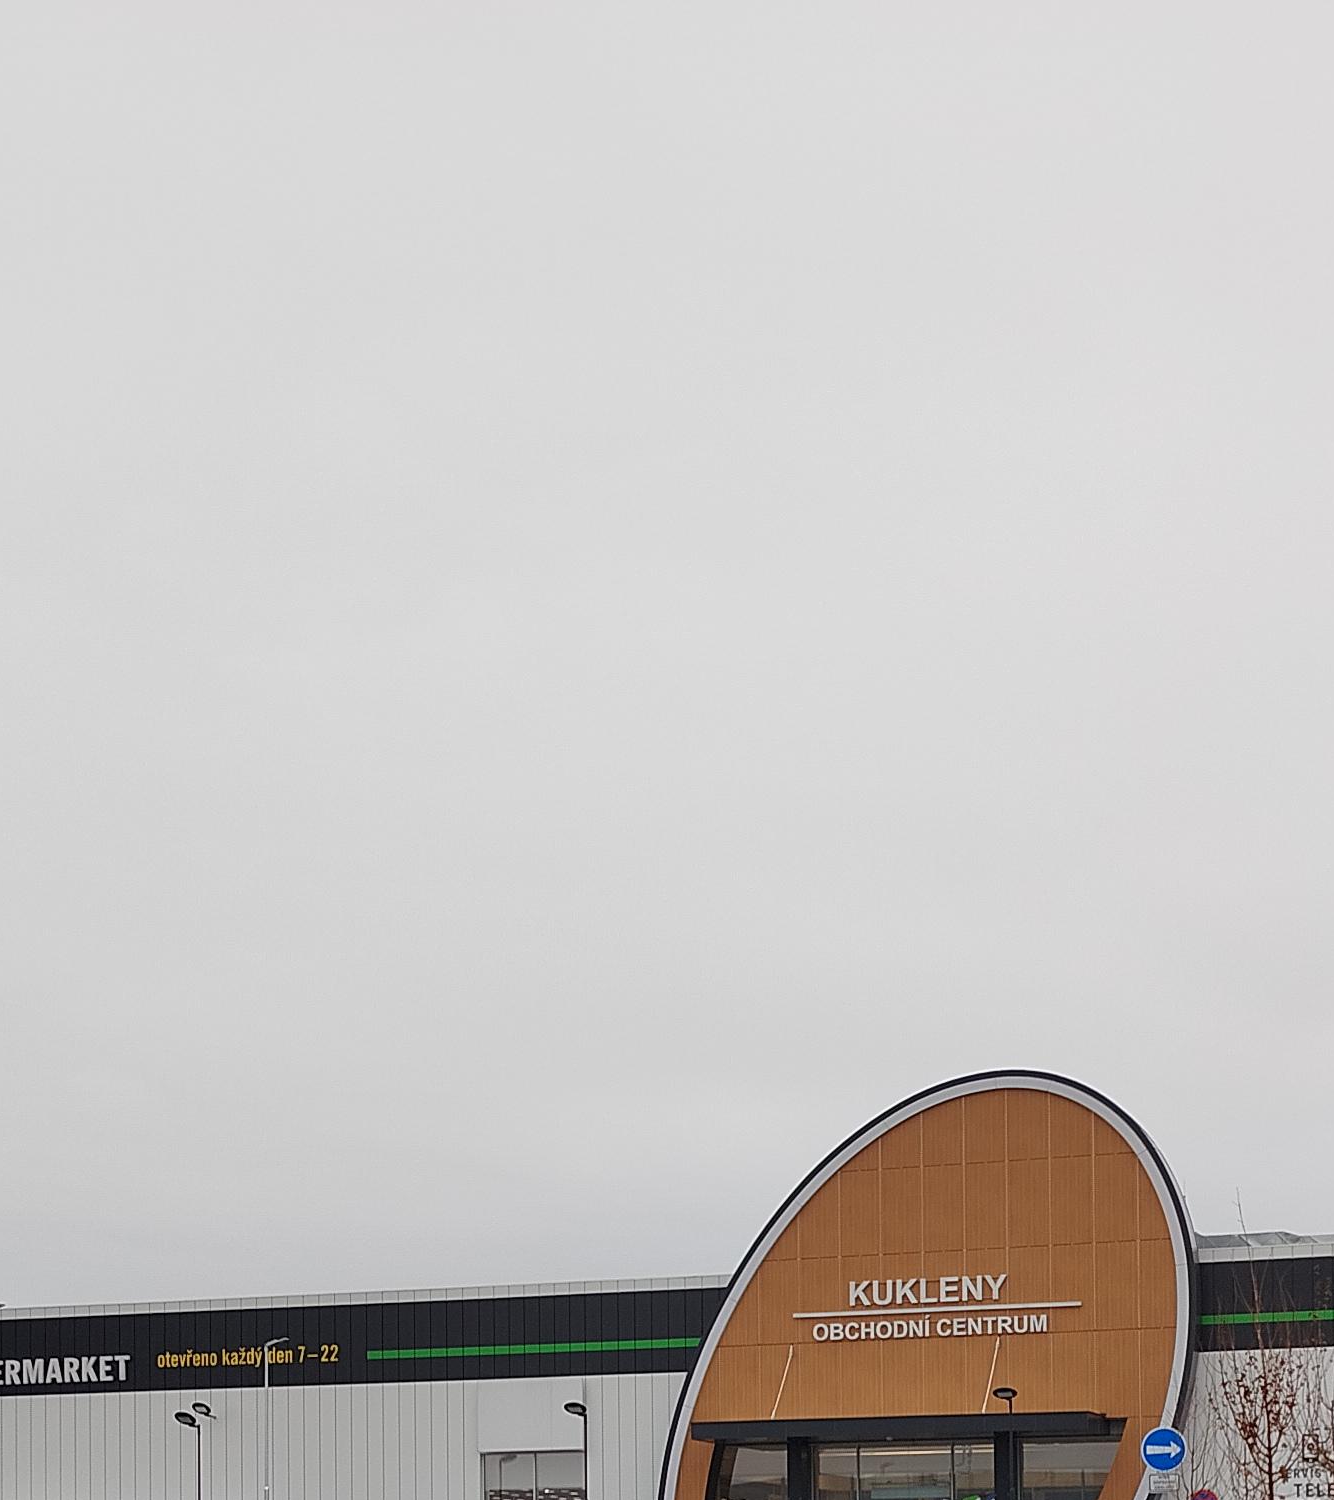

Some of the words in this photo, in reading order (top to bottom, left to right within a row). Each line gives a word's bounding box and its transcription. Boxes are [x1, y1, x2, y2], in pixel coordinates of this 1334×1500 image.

[848, 1273, 1008, 1306] KUKLENY
[812, 1315, 931, 1342] OBCHODNÍ
[935, 1313, 1049, 1337] CENTRUM
[157, 1349, 218, 1369] otevřeno
[221, 1346, 263, 1368] každý
[267, 1346, 293, 1364] den
